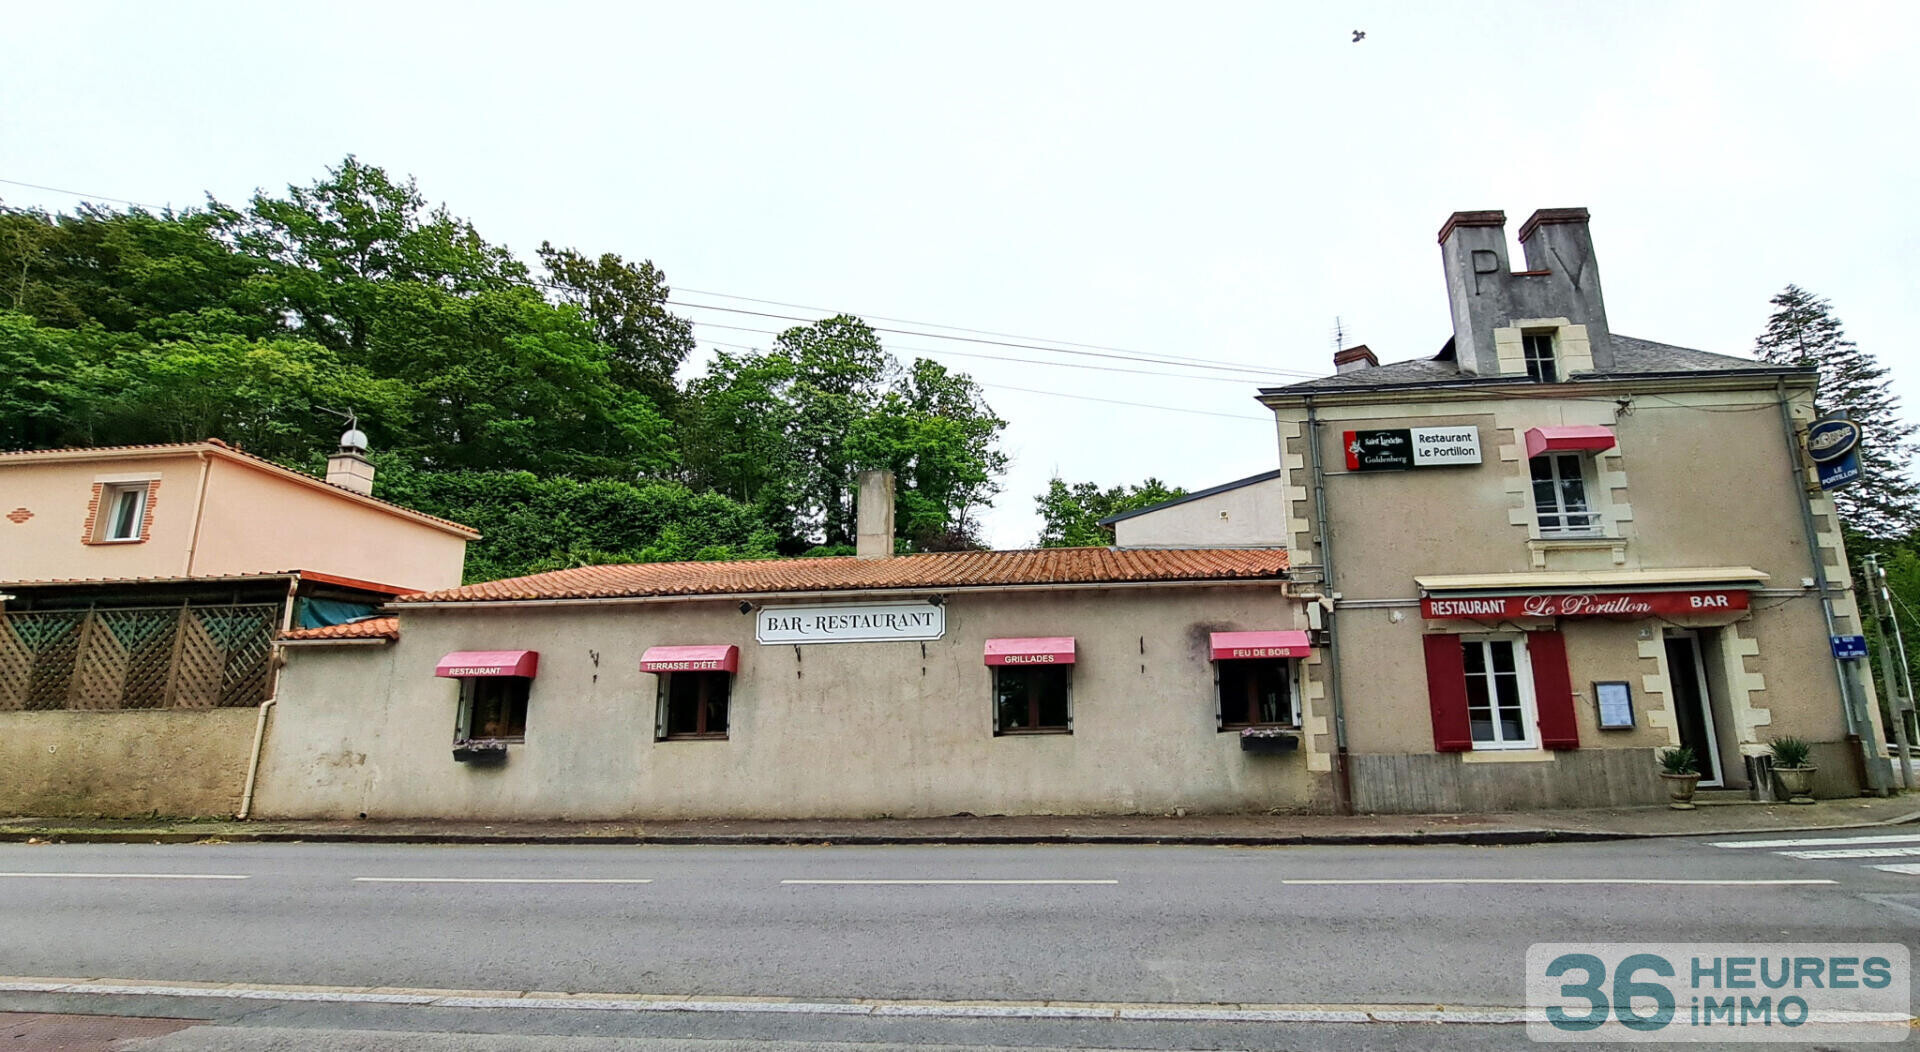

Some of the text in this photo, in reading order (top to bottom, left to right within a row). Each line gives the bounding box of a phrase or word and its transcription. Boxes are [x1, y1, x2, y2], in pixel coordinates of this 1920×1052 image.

[1419, 433, 1472, 444] Restaurant
[1419, 446, 1475, 457] Le Portillon
[1365, 455, 1407, 465] Goldenberg
[1833, 466, 1843, 474] LE
[1822, 468, 1858, 485] PORTILLON
[1431, 594, 1728, 616] RESTAURANT Le Portillon BAR
[1233, 649, 1251, 657] FEU
[1268, 648, 1290, 656] BOIS
[1004, 654, 1055, 664] GRILLADES
[647, 659, 717, 670] TERRASSE D'ÉTÉ
[449, 667, 501, 675] RESTAURANT
